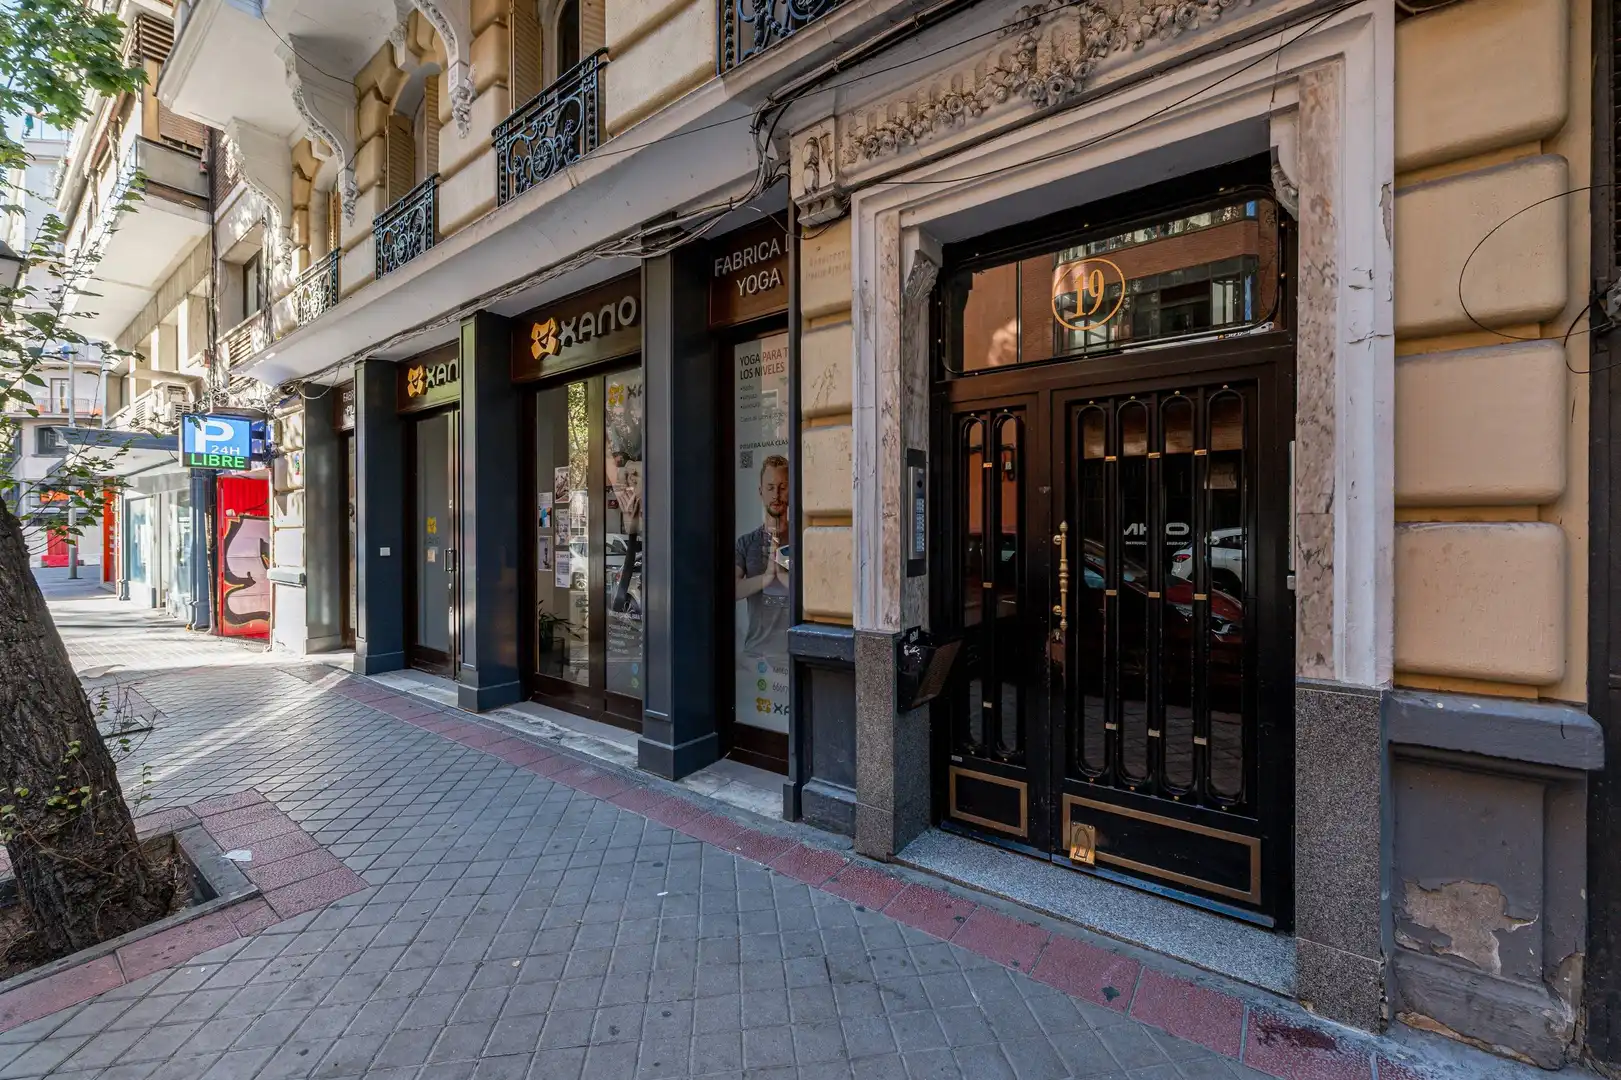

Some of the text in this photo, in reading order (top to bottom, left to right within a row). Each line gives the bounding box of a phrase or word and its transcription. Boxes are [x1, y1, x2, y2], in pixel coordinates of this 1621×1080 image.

[714, 237, 781, 278] FABRICA
[737, 267, 781, 297] YOGA
[1073, 268, 1106, 320] 19
[558, 295, 637, 347] XANO
[740, 352, 761, 367] YOGA
[762, 348, 783, 362] PARA
[425, 358, 460, 389] XAN
[740, 361, 785, 380] LOS NIVELES
[194, 419, 235, 453] P
[775, 437, 789, 447] CLAS
[191, 453, 245, 468] LIBRE
[211, 445, 240, 457] 24H
[774, 702, 790, 716] XA
